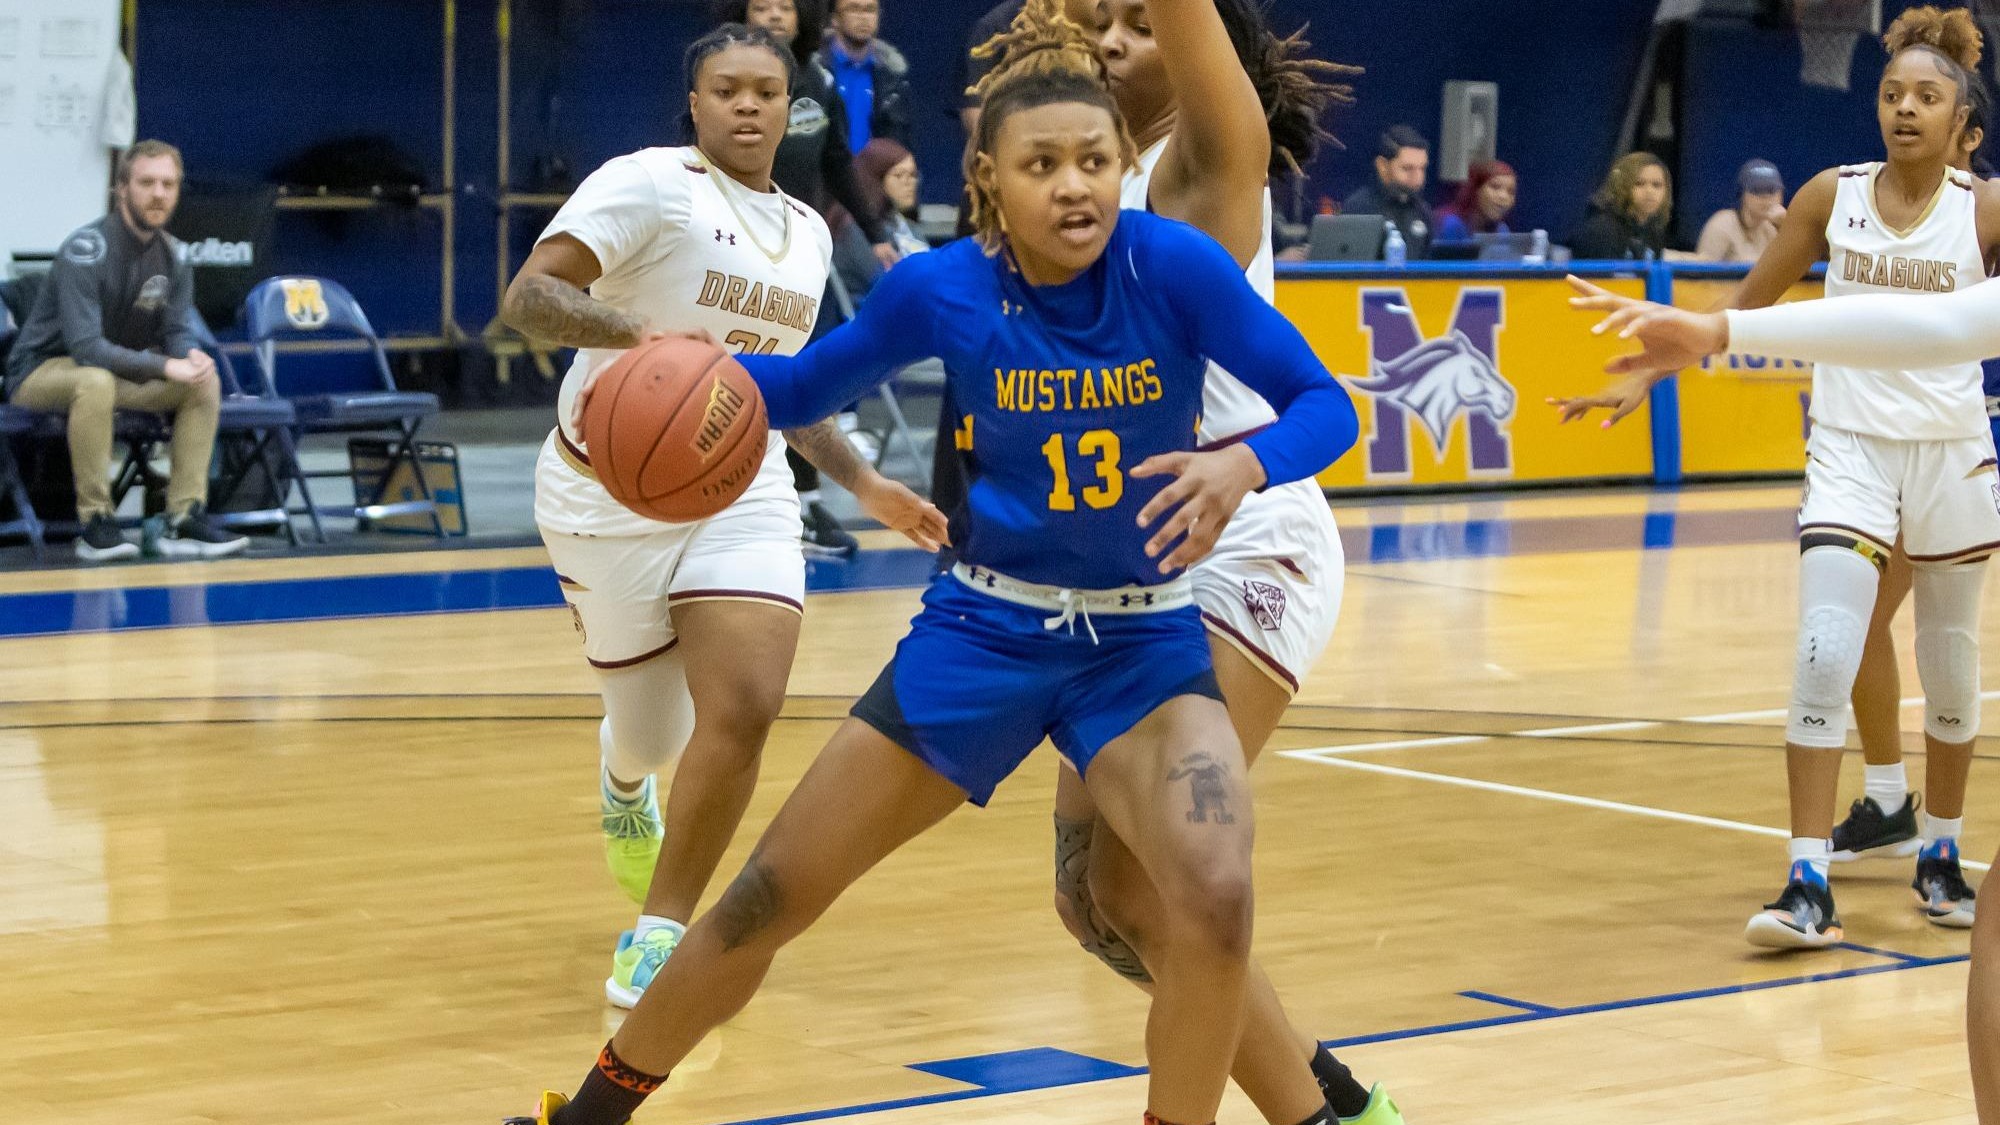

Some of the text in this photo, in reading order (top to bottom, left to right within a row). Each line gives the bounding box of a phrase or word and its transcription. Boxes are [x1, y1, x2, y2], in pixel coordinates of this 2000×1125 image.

[1843, 249, 1957, 293] DRAGONS
[696, 269, 817, 334] DRAGONS
[994, 358, 1164, 412] MUSTANGS
[1041, 429, 1124, 512] 13
